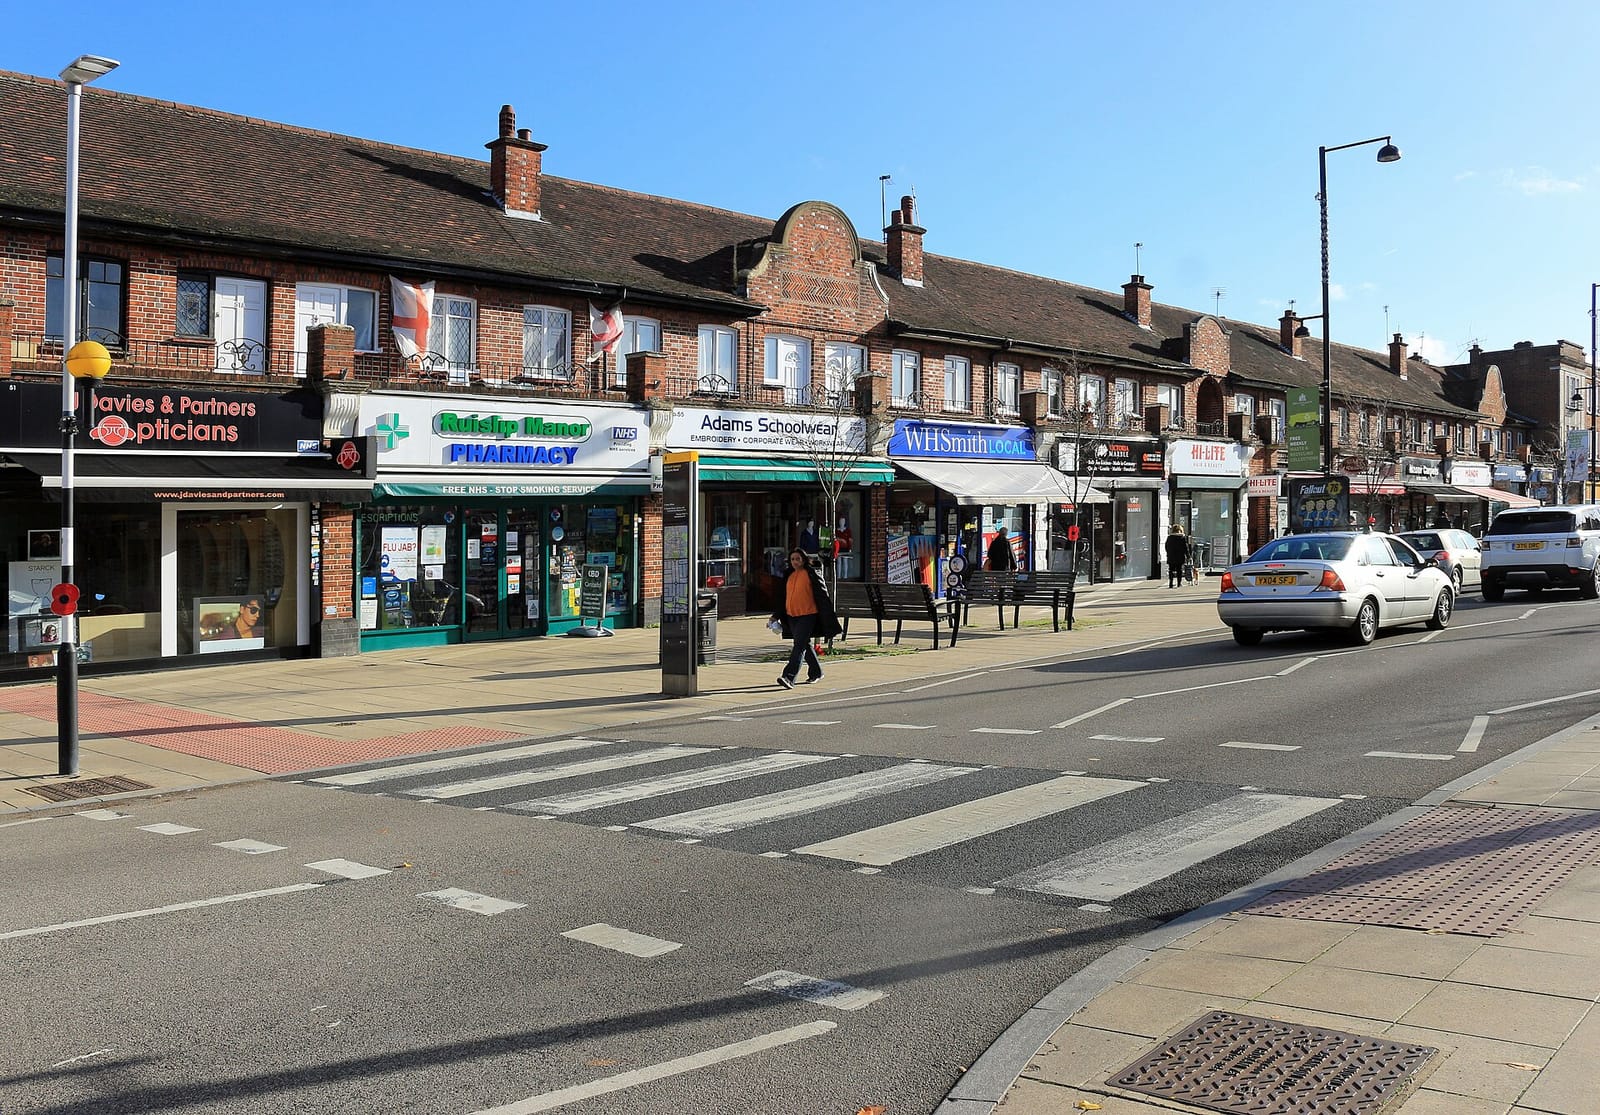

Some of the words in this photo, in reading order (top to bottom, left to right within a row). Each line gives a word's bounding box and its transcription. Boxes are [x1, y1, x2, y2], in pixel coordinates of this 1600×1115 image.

[160, 395, 174, 414] &
[180, 396, 257, 417] Partners
[441, 413, 519, 438] Ruislip
[525, 416, 591, 438] Manor
[701, 414, 753, 432] Adams
[758, 417, 838, 436] Schoolwear
[615, 428, 637, 439] NHS
[299, 441, 319, 450] NHS
[690, 434, 737, 444] EMBROIDERY
[743, 436, 784, 446] CORPORATE
[903, 426, 988, 454] WHSmith
[988, 439, 1027, 455] LOCAL
[450, 444, 579, 465] PHARMACY
[153, 490, 285, 500] www.jdaviesandpartners.com
[442, 486, 466, 494] FREE
[468, 486, 488, 494] NHS
[495, 486, 518, 494] STOP
[520, 486, 560, 494] SMOKING
[562, 485, 596, 493] SERVICE
[1300, 484, 1326, 495] Fallout
[383, 542, 397, 552] FLU
[397, 542, 417, 552] JAB?
[28, 564, 55, 572] STARCK
